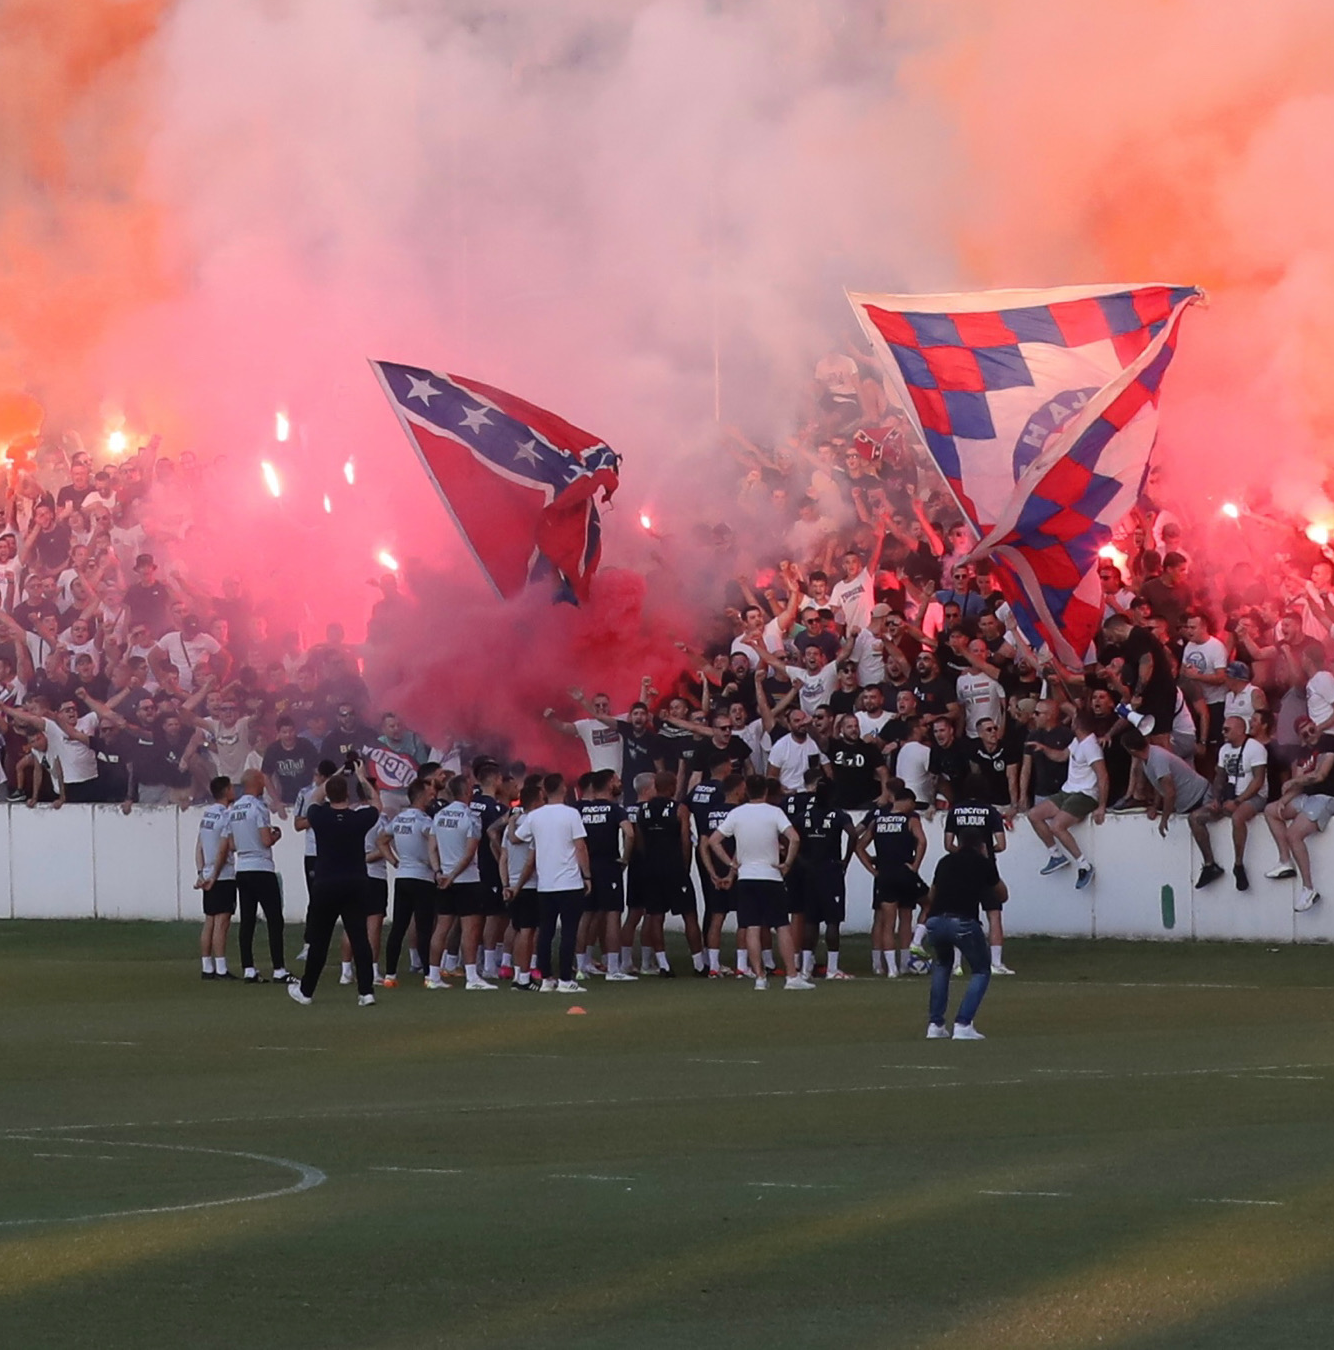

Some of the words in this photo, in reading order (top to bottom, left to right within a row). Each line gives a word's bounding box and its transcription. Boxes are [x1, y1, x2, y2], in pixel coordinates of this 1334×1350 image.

[582, 804, 611, 813] macron
[953, 807, 990, 815] macron
[877, 815, 907, 824] macron
[956, 816, 986, 826] HAJDUK
